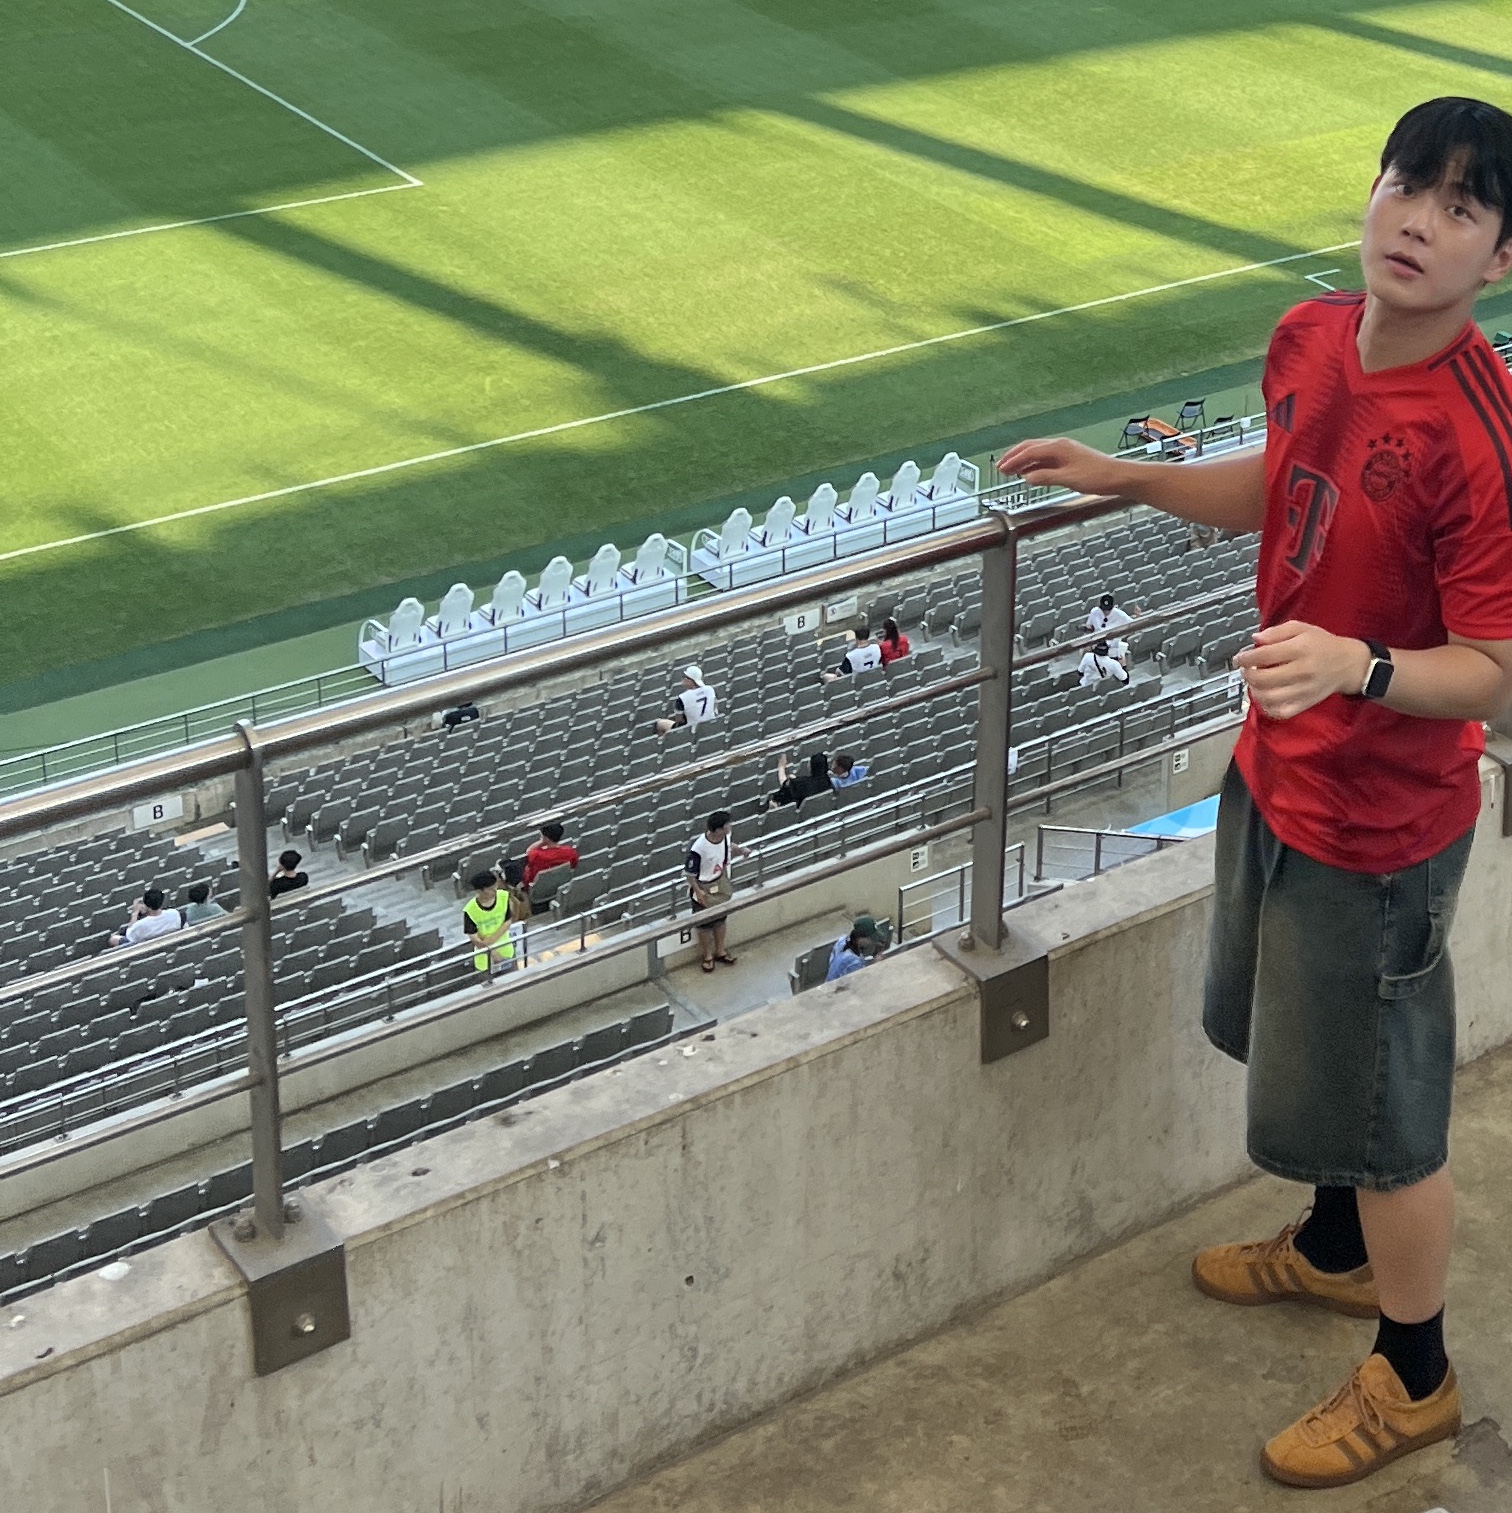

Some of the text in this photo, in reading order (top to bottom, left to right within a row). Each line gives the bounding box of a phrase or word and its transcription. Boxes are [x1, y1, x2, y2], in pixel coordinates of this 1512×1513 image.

[797, 615, 806, 629] B
[696, 696, 708, 717] 7
[153, 804, 164, 819] B
[680, 930, 691, 945] B
